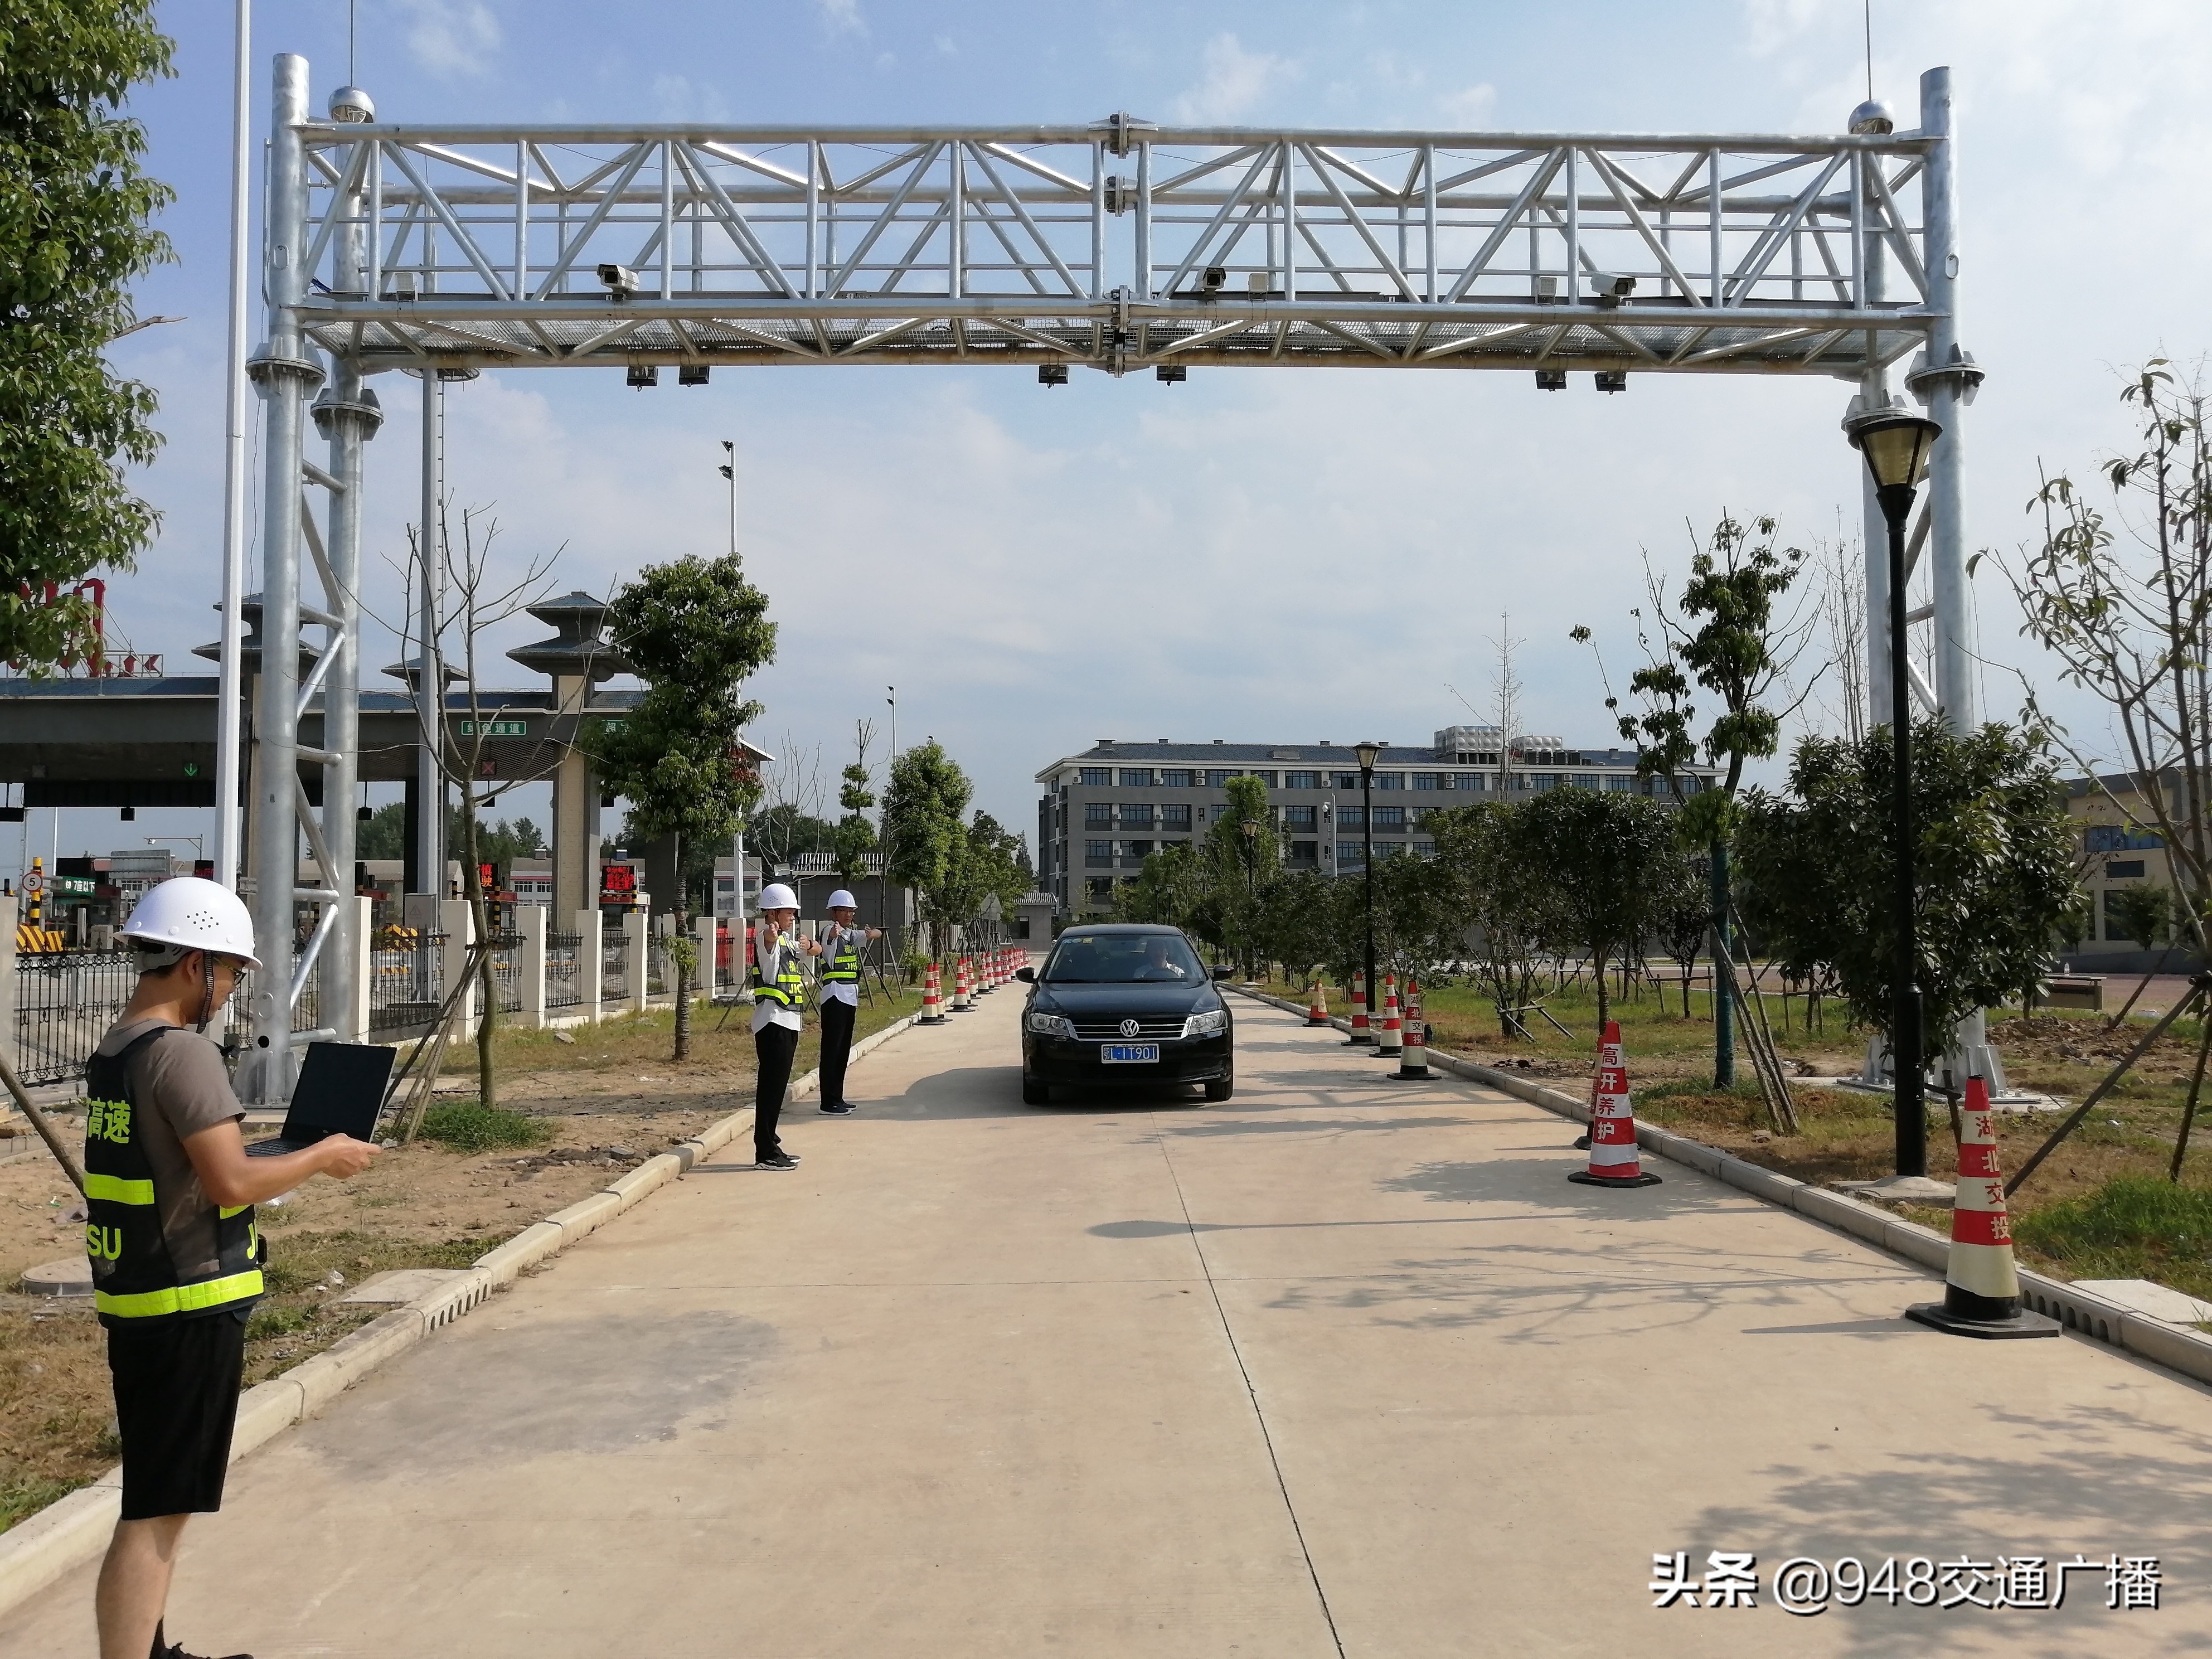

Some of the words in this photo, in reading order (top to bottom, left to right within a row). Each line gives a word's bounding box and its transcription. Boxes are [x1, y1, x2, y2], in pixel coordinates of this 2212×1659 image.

[29, 877, 36, 886] 5
[1410, 995, 1423, 1045] 湖北交投
[1597, 1046, 1618, 1141] 高开养护
[1975, 1115, 2010, 1240] 湖北交投
